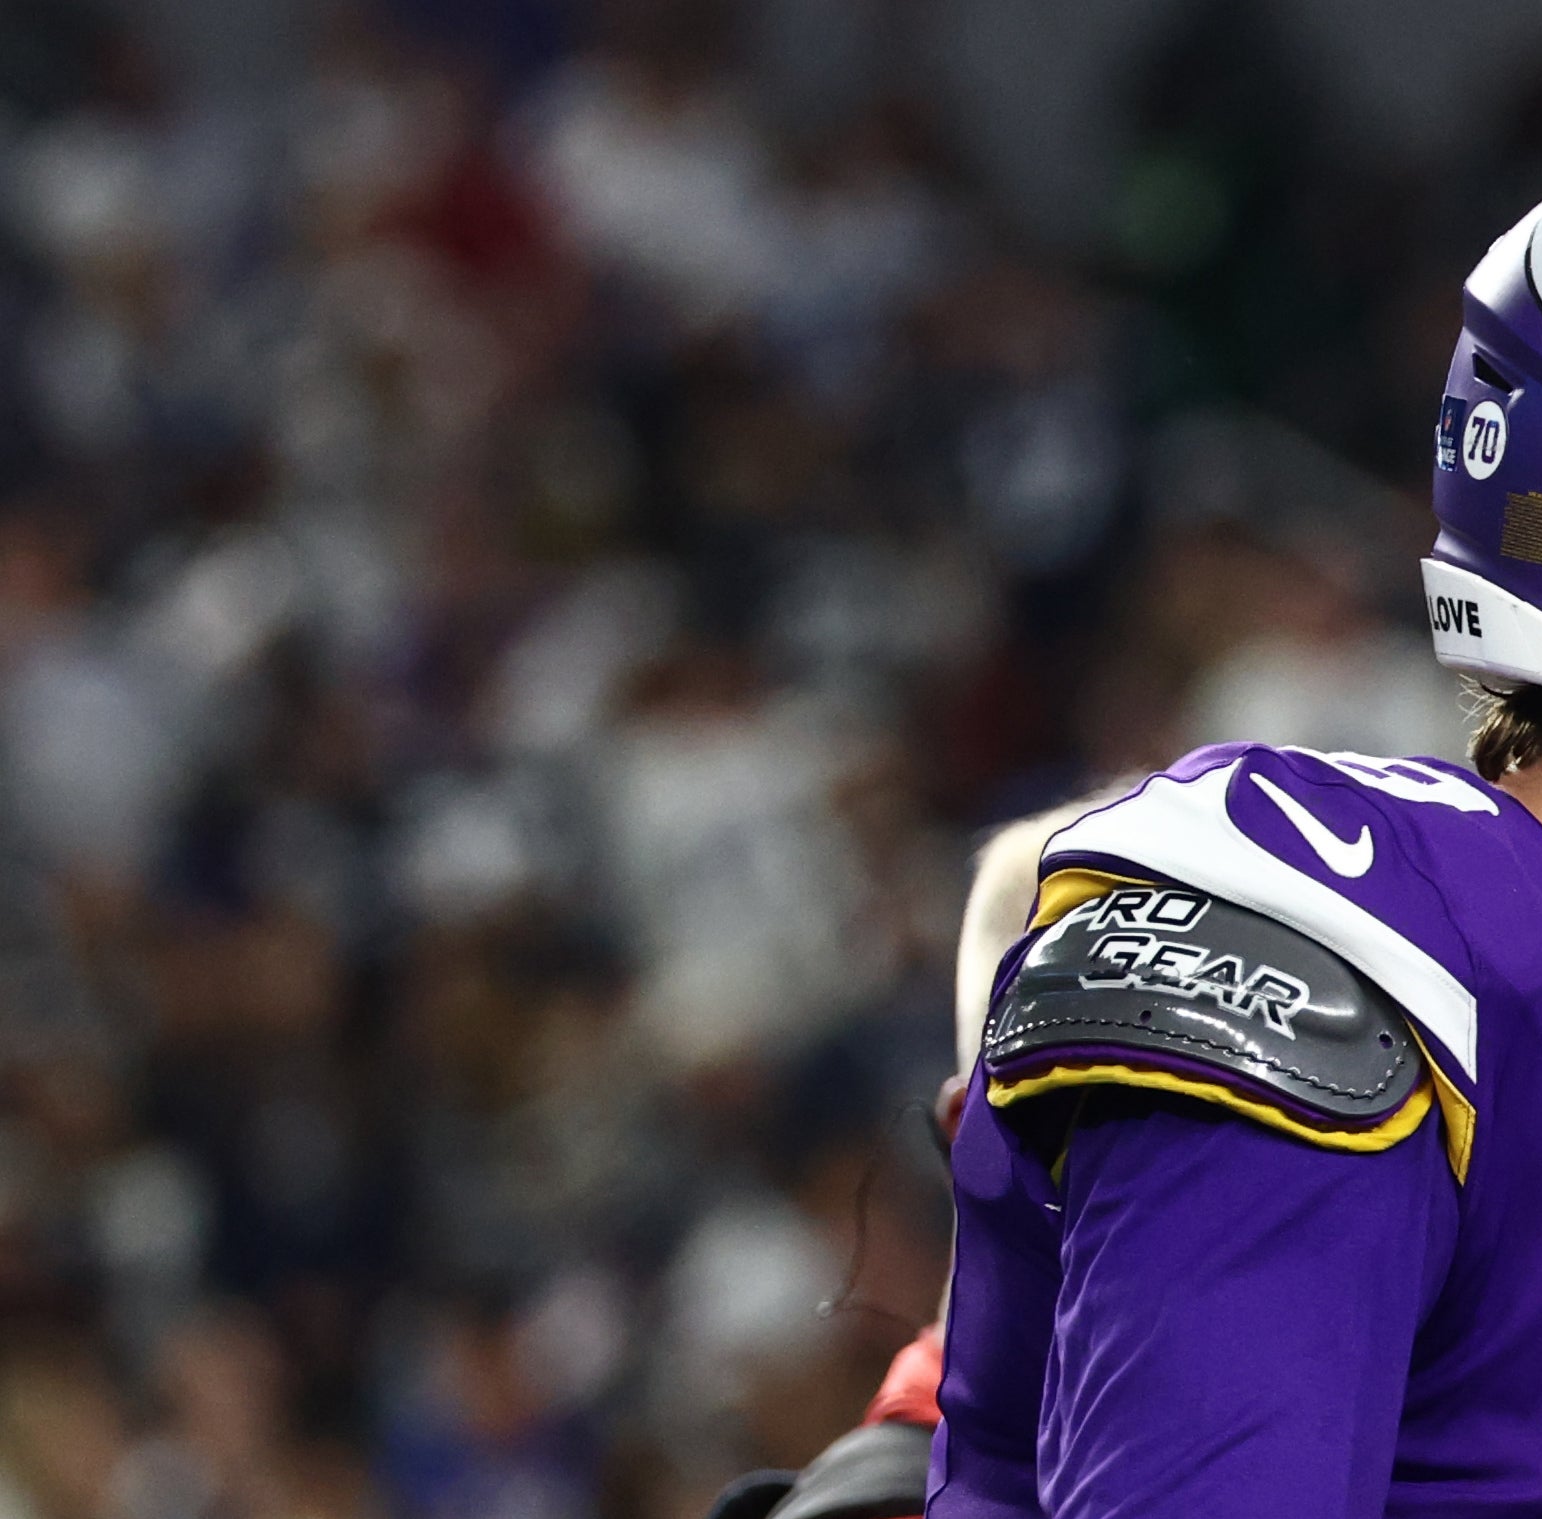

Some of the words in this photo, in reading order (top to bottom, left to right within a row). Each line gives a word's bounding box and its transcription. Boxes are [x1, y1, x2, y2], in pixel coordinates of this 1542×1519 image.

[1467, 415, 1500, 464] 70
[1429, 595, 1483, 638] LOVE
[1078, 931, 1311, 1041] GEAR
